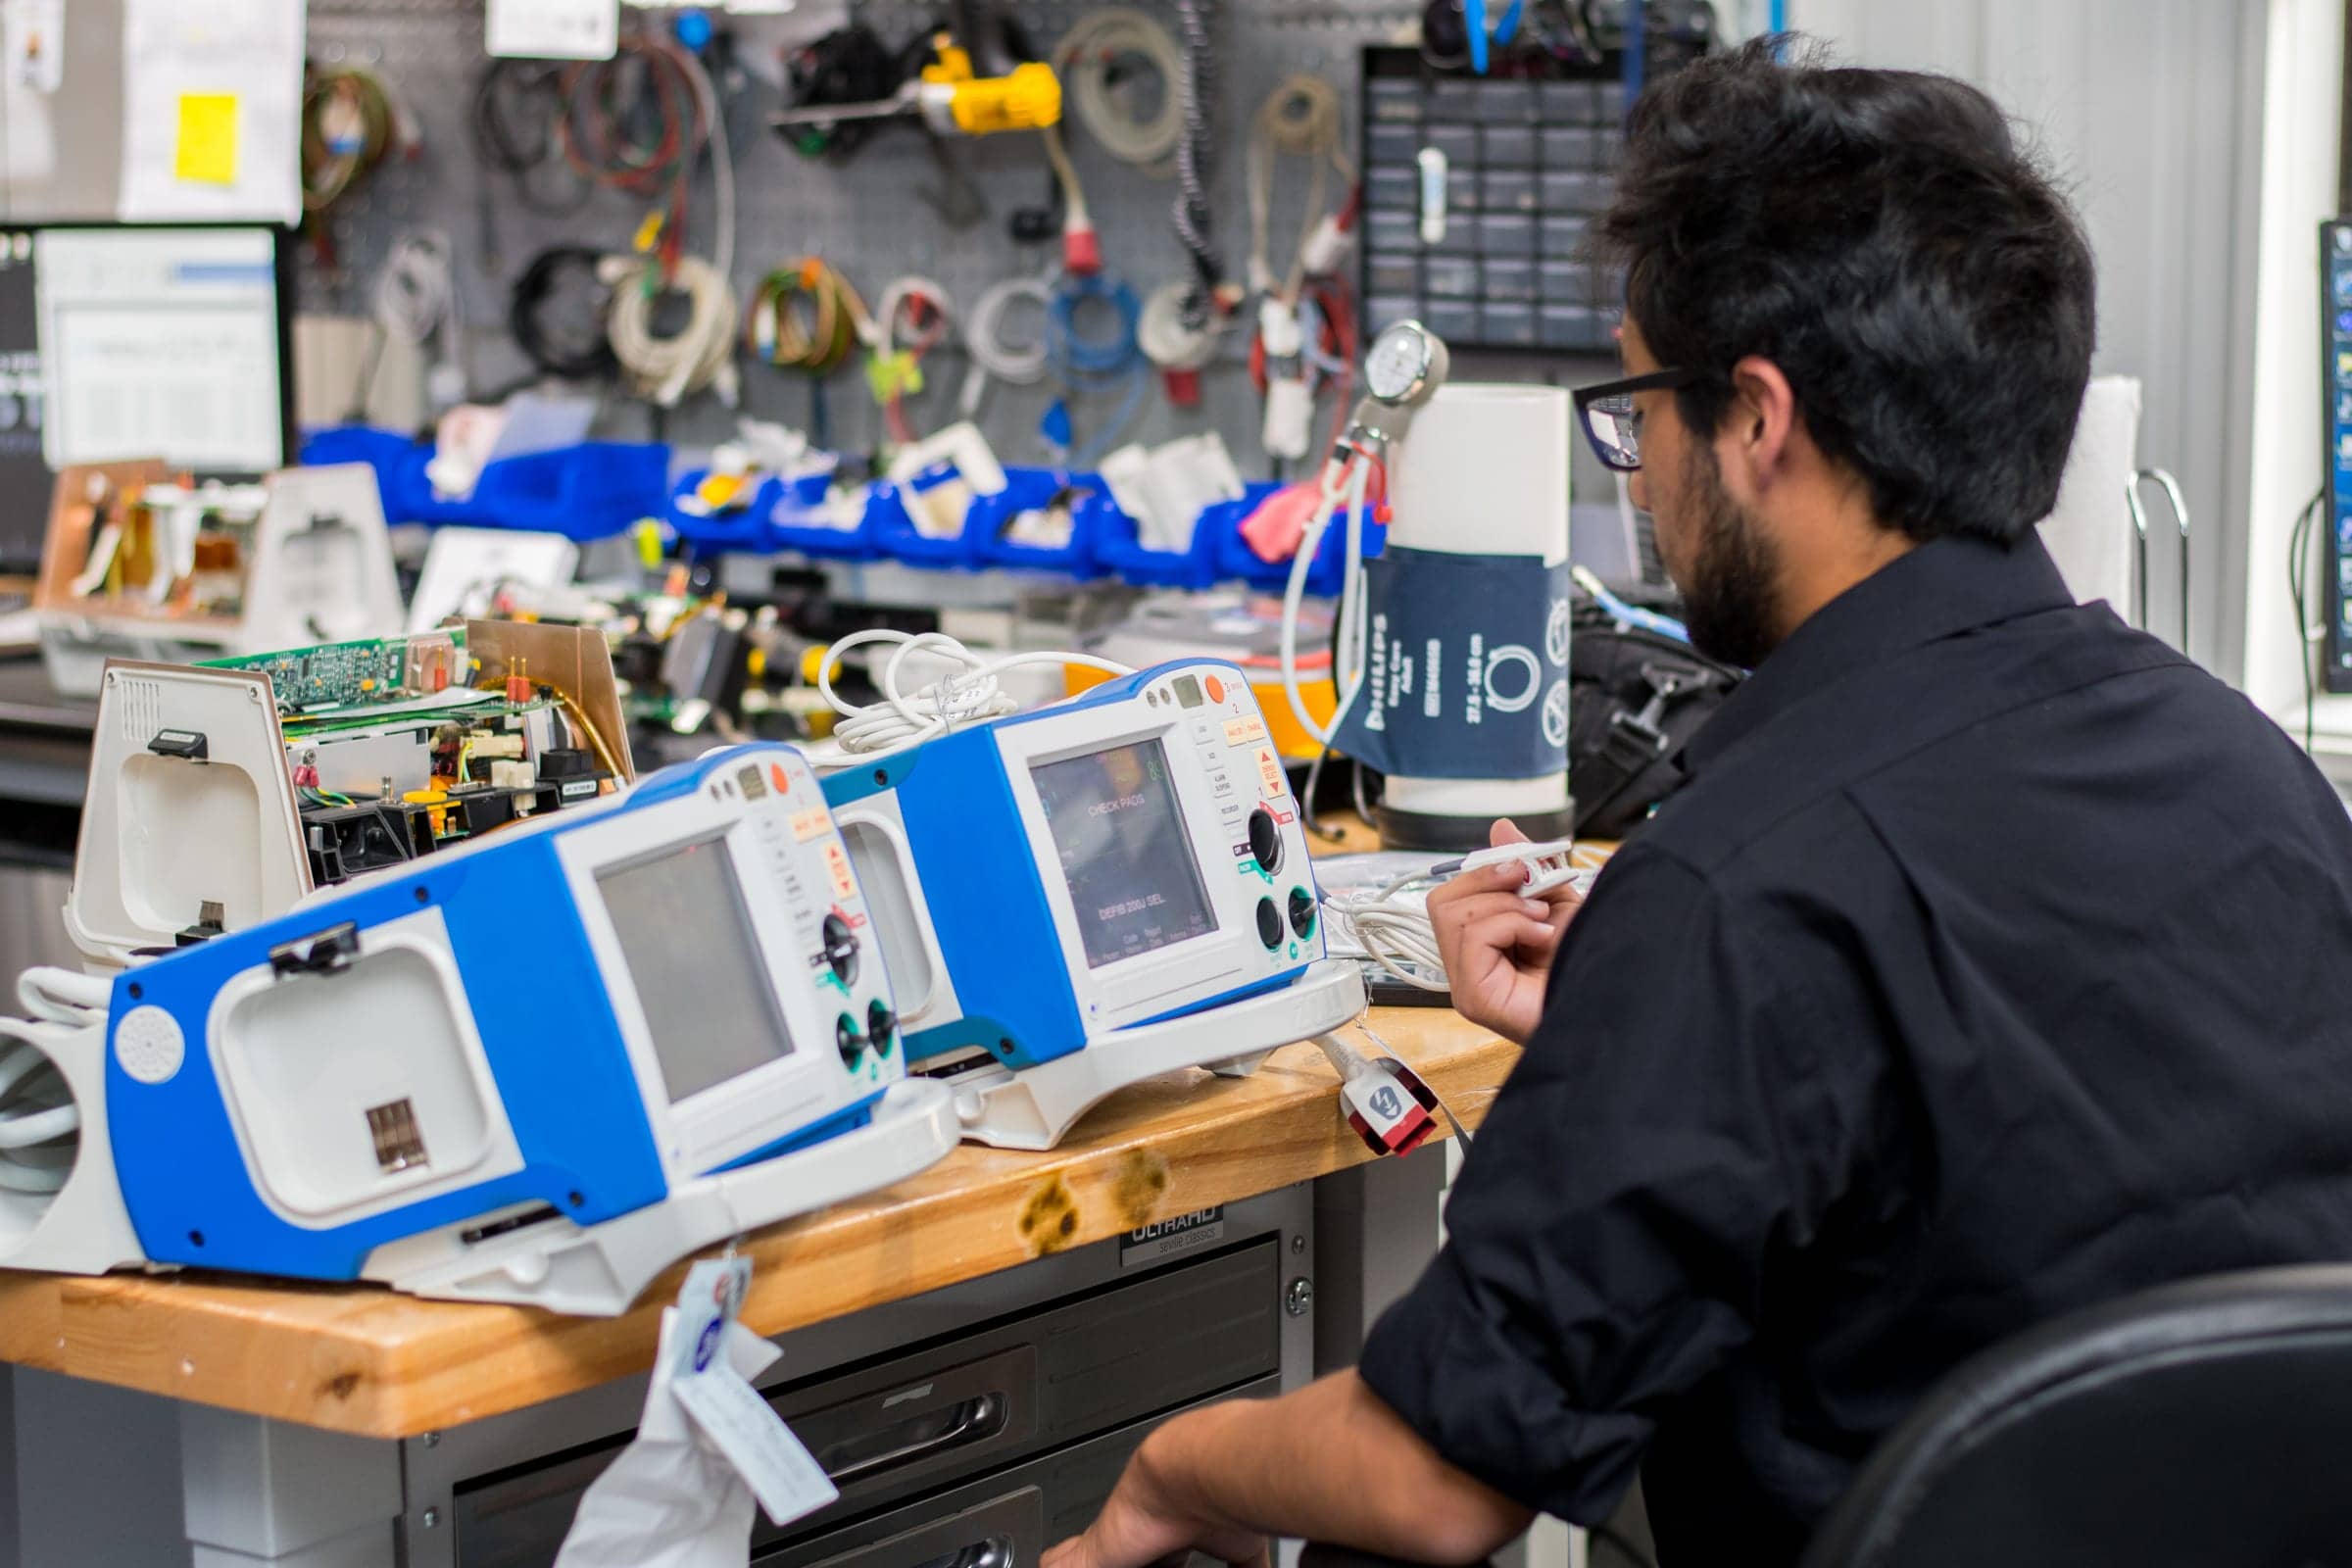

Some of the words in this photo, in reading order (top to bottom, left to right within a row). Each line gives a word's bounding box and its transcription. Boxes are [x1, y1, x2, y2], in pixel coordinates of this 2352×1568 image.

[1364, 613, 1388, 731] PHILIPS
[1088, 799, 1120, 817] CHECK
[1119, 793, 1146, 809] PADS
[1132, 1206, 1216, 1243] ULTRAHD
